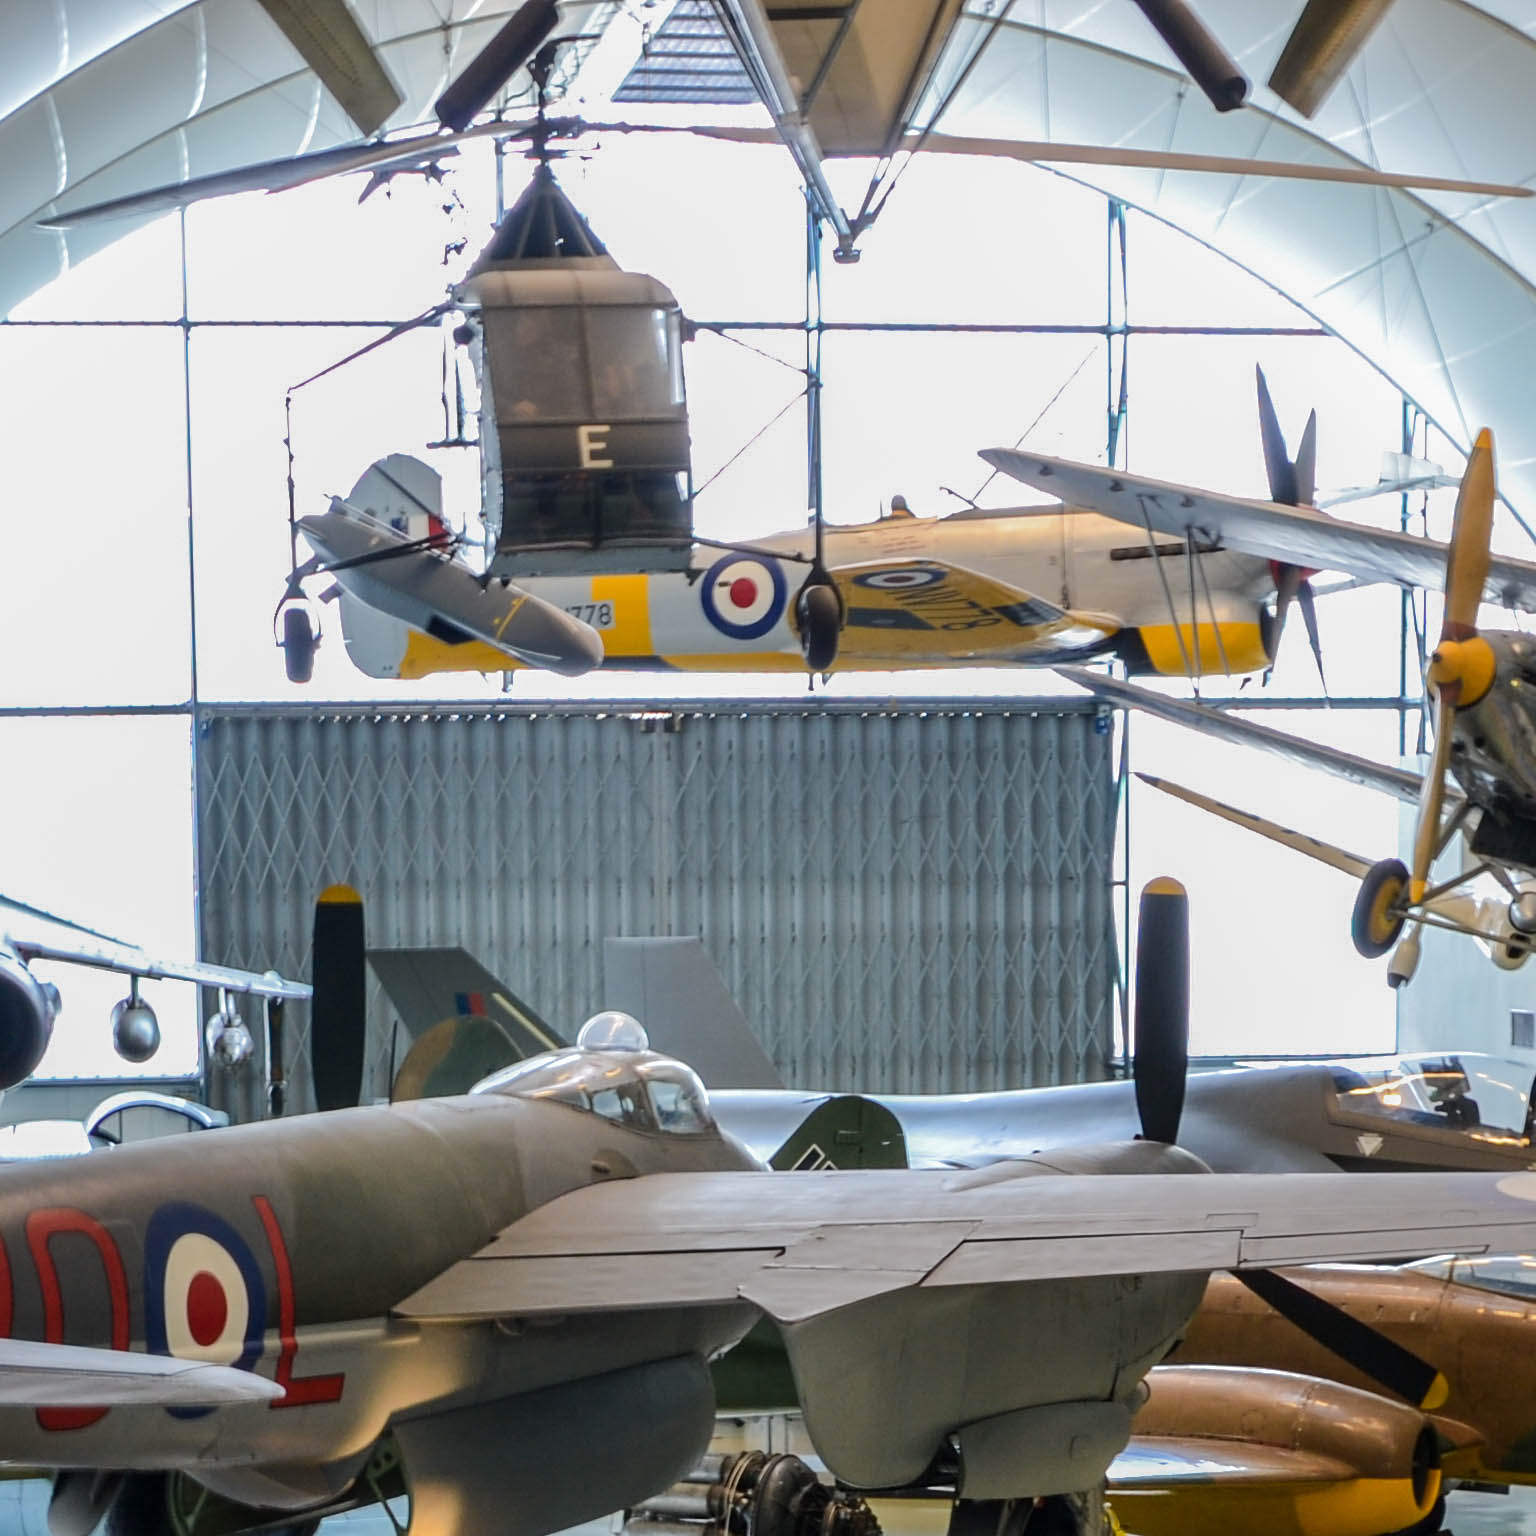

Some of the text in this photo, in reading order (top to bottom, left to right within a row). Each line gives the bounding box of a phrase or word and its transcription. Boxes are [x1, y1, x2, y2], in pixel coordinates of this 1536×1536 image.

[578, 424, 613, 468] E
[565, 603, 611, 626] 778
[252, 1195, 345, 1409] L
